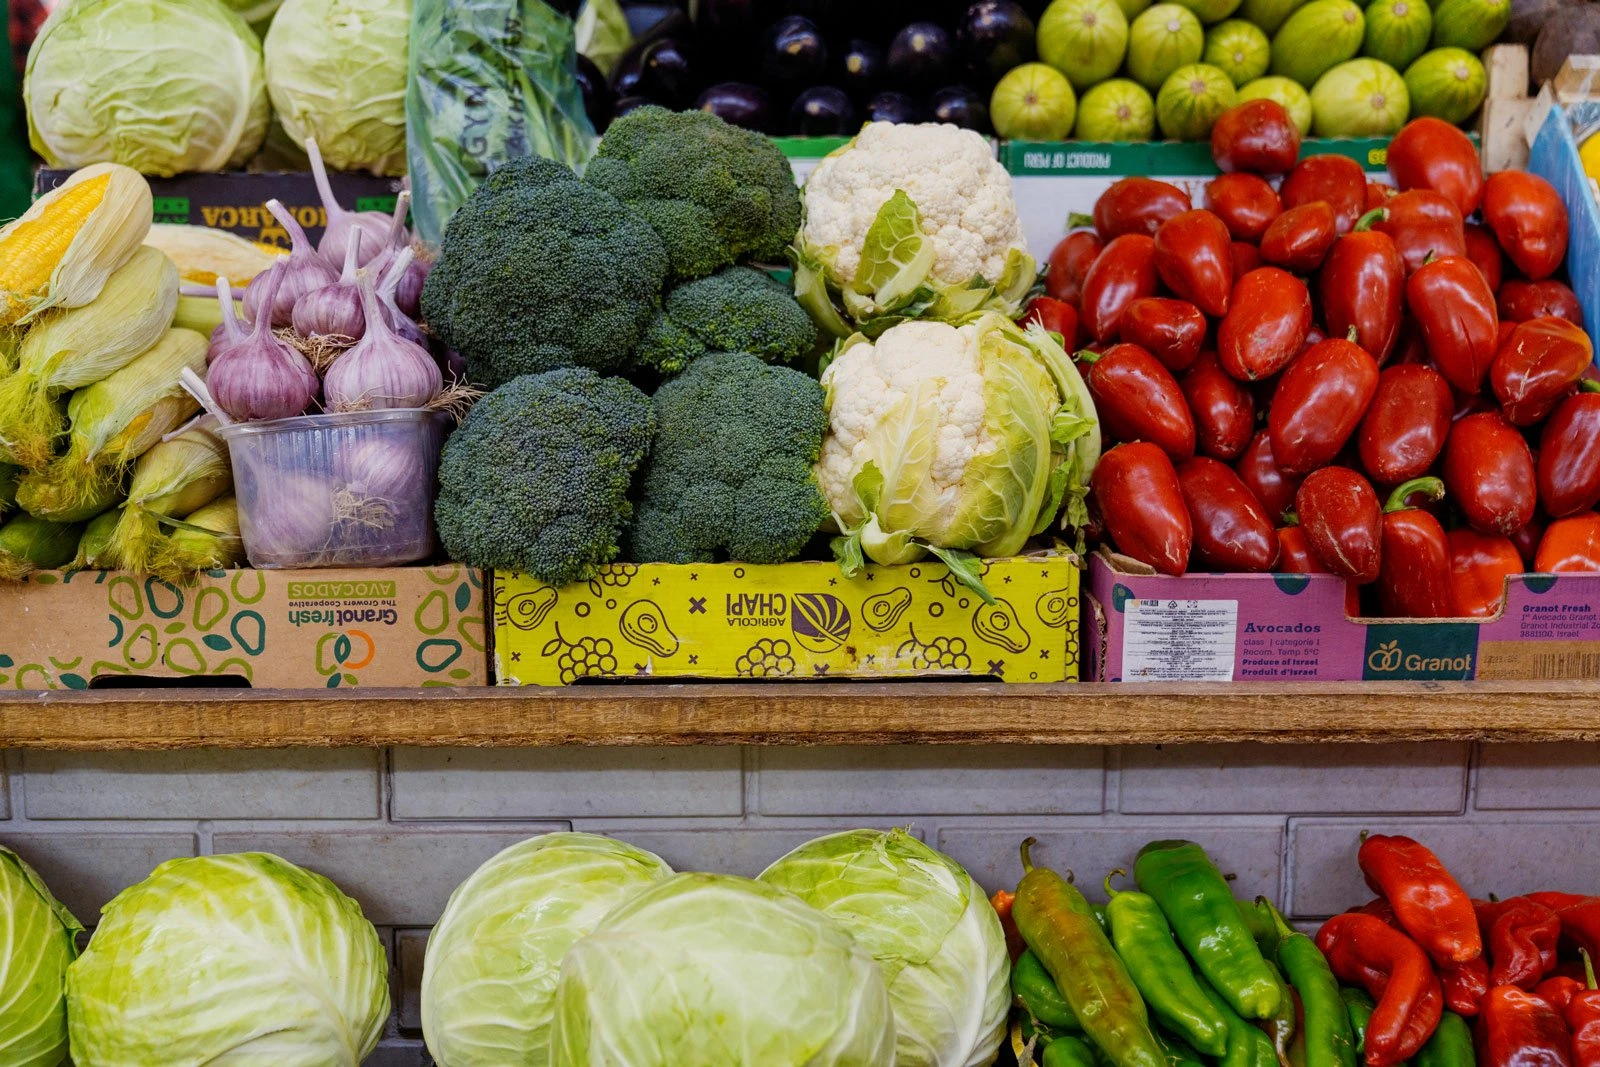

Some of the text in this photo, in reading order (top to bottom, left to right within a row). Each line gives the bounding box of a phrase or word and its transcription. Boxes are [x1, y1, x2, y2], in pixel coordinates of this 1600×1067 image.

[1023, 152, 1112, 169] PRODUCT OF PERU
[291, 583, 392, 597] AVOCADOS
[288, 600, 341, 608] Cooperative
[381, 599, 396, 607] The
[726, 593, 787, 616] CHAPI
[1523, 604, 1591, 613] Granot Fresh
[1532, 613, 1567, 621] Avocado
[1569, 613, 1597, 621] Granot
[1244, 622, 1321, 633] Avocados
[1520, 622, 1548, 630] Granot
[1550, 622, 1589, 630] Industrial
[1556, 630, 1579, 638] Israel
[1243, 638, 1265, 646] class
[1275, 638, 1314, 647] categorie
[1243, 648, 1275, 656] Recom.
[1278, 648, 1301, 657] Temp
[1242, 658, 1318, 666] Produce of Israel
[1405, 653, 1472, 671] Granot
[1242, 668, 1317, 676] Produit d'Israel
